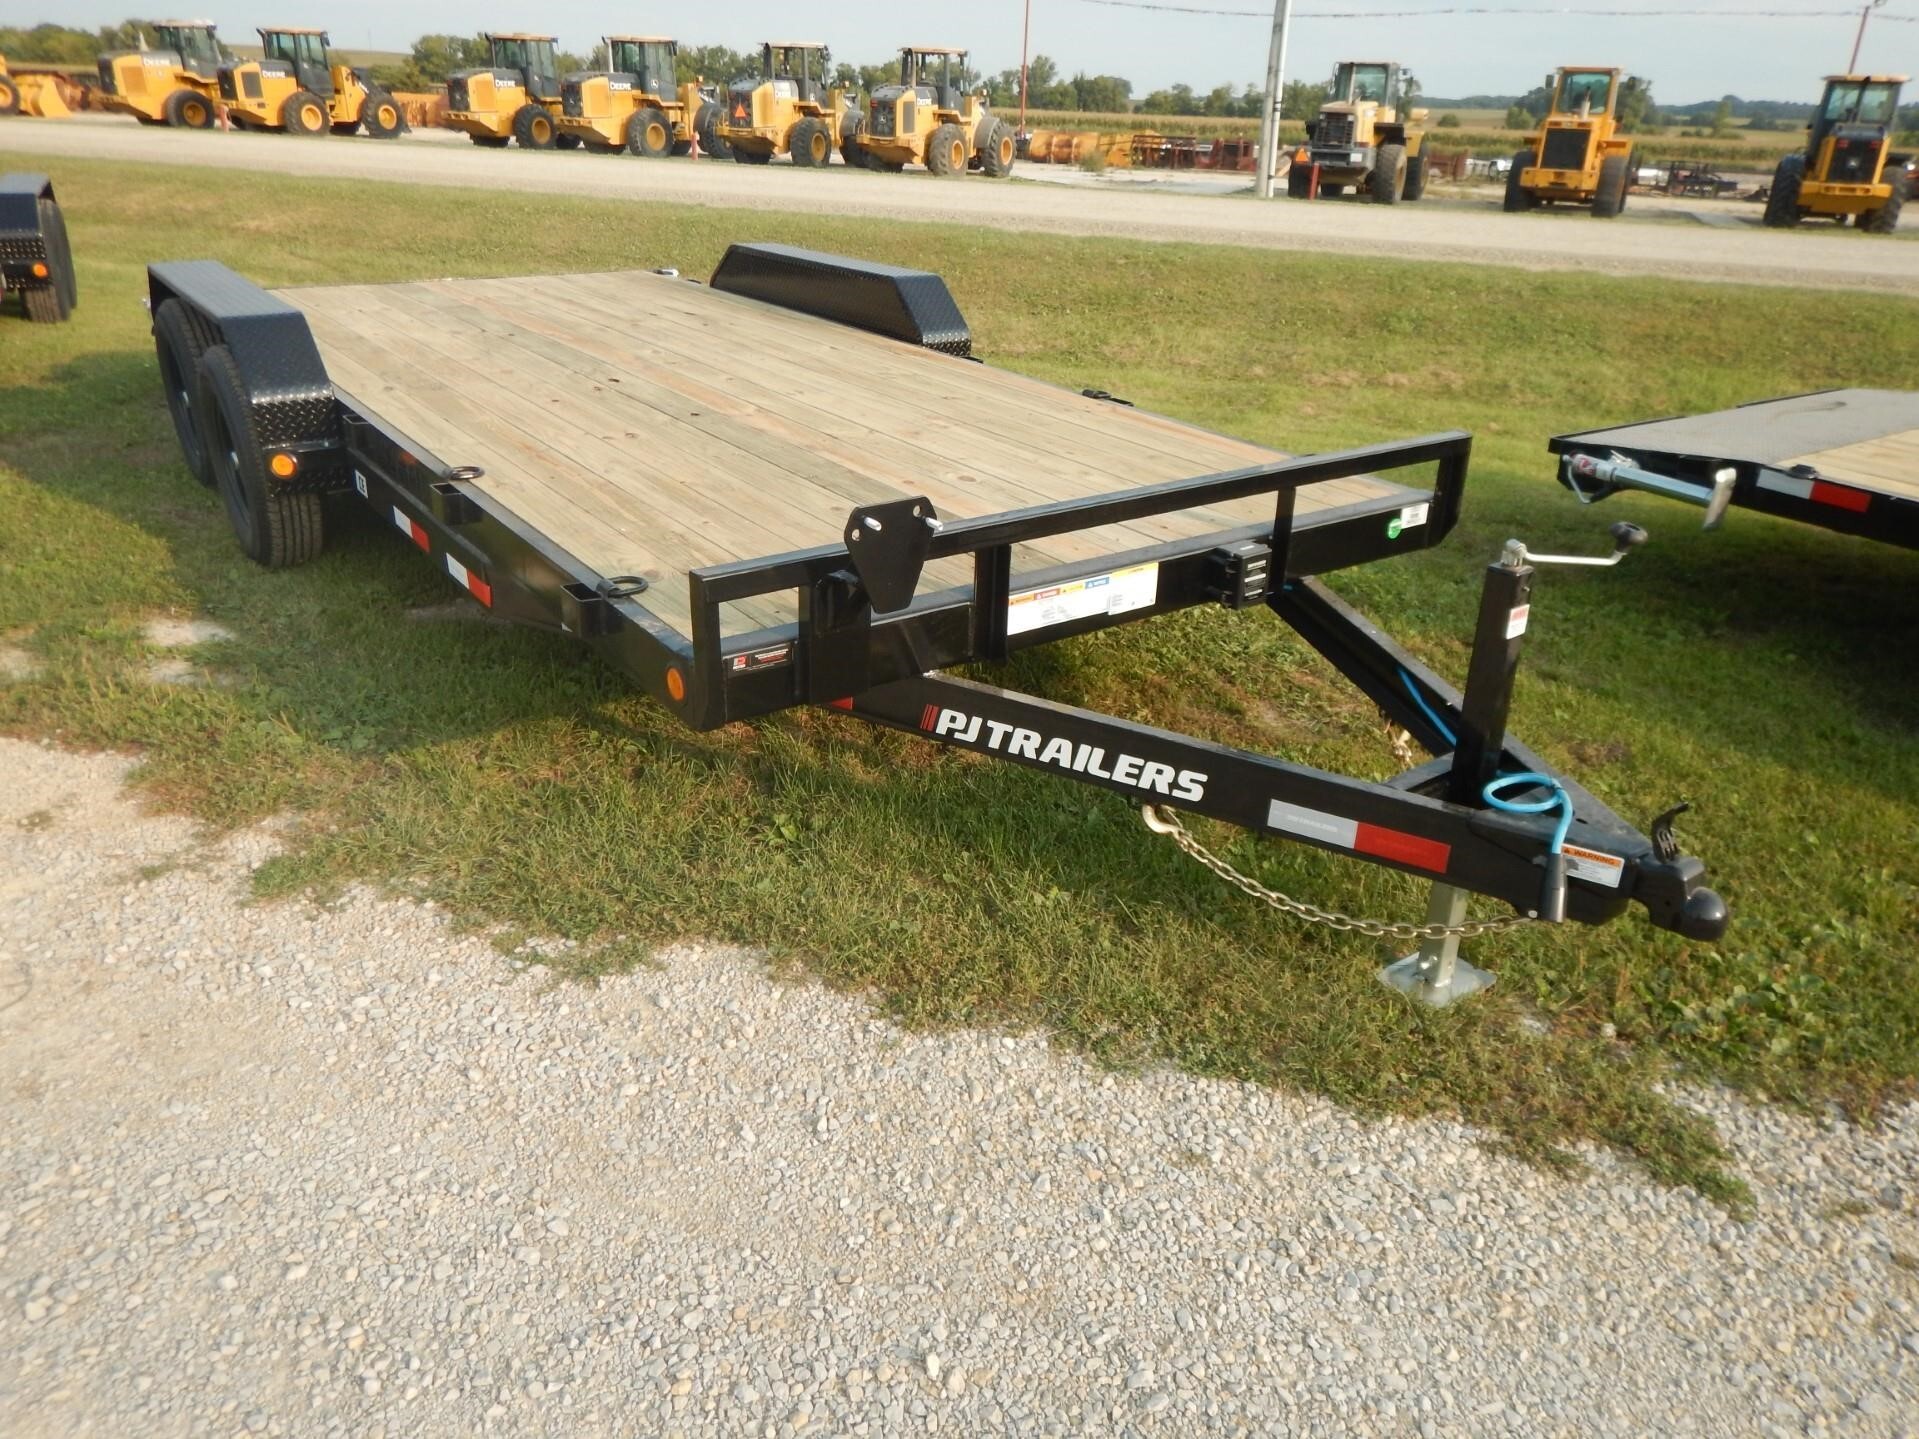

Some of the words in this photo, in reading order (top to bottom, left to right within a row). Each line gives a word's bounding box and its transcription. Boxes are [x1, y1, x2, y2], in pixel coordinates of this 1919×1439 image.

[262, 70, 286, 79] DEERE
[495, 79, 516, 88] DEERE
[609, 81, 632, 90] DEERE
[935, 708, 983, 743] PJ
[987, 719, 1209, 802] TRAILERS
[1574, 849, 1615, 865] WARNING
